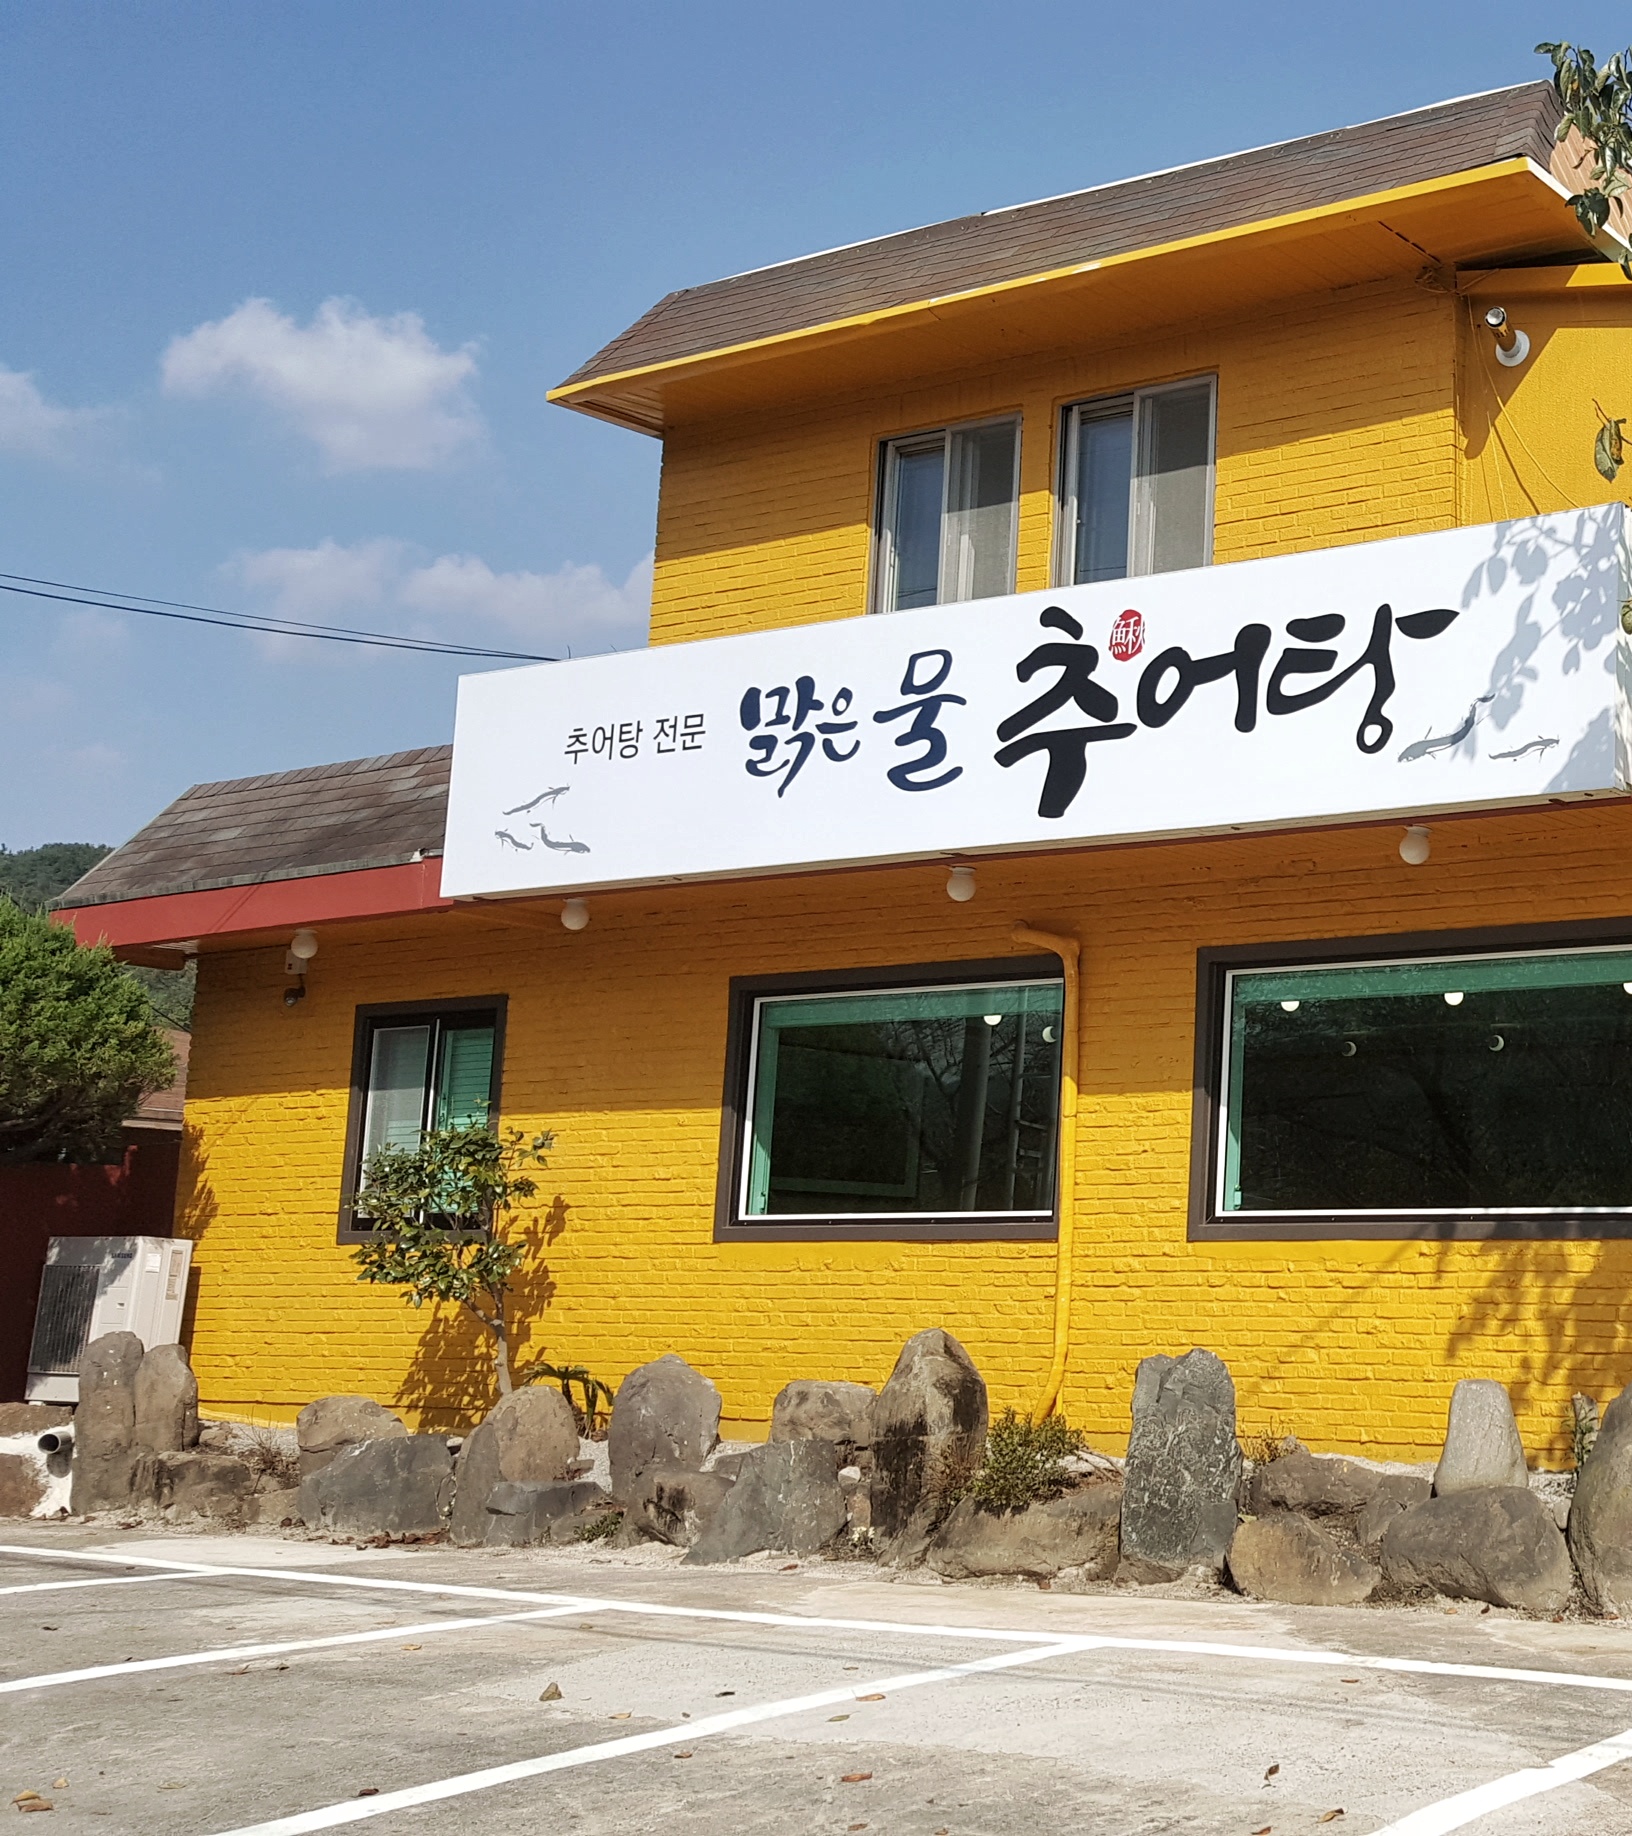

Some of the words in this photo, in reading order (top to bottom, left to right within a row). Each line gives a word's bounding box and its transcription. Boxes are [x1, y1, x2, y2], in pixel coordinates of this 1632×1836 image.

[563, 719, 645, 766] 추어탕
[652, 713, 707, 755] 전문
[740, 675, 858, 798] 맑은
[873, 648, 967, 792] 물
[993, 603, 1460, 818] 추어탕
